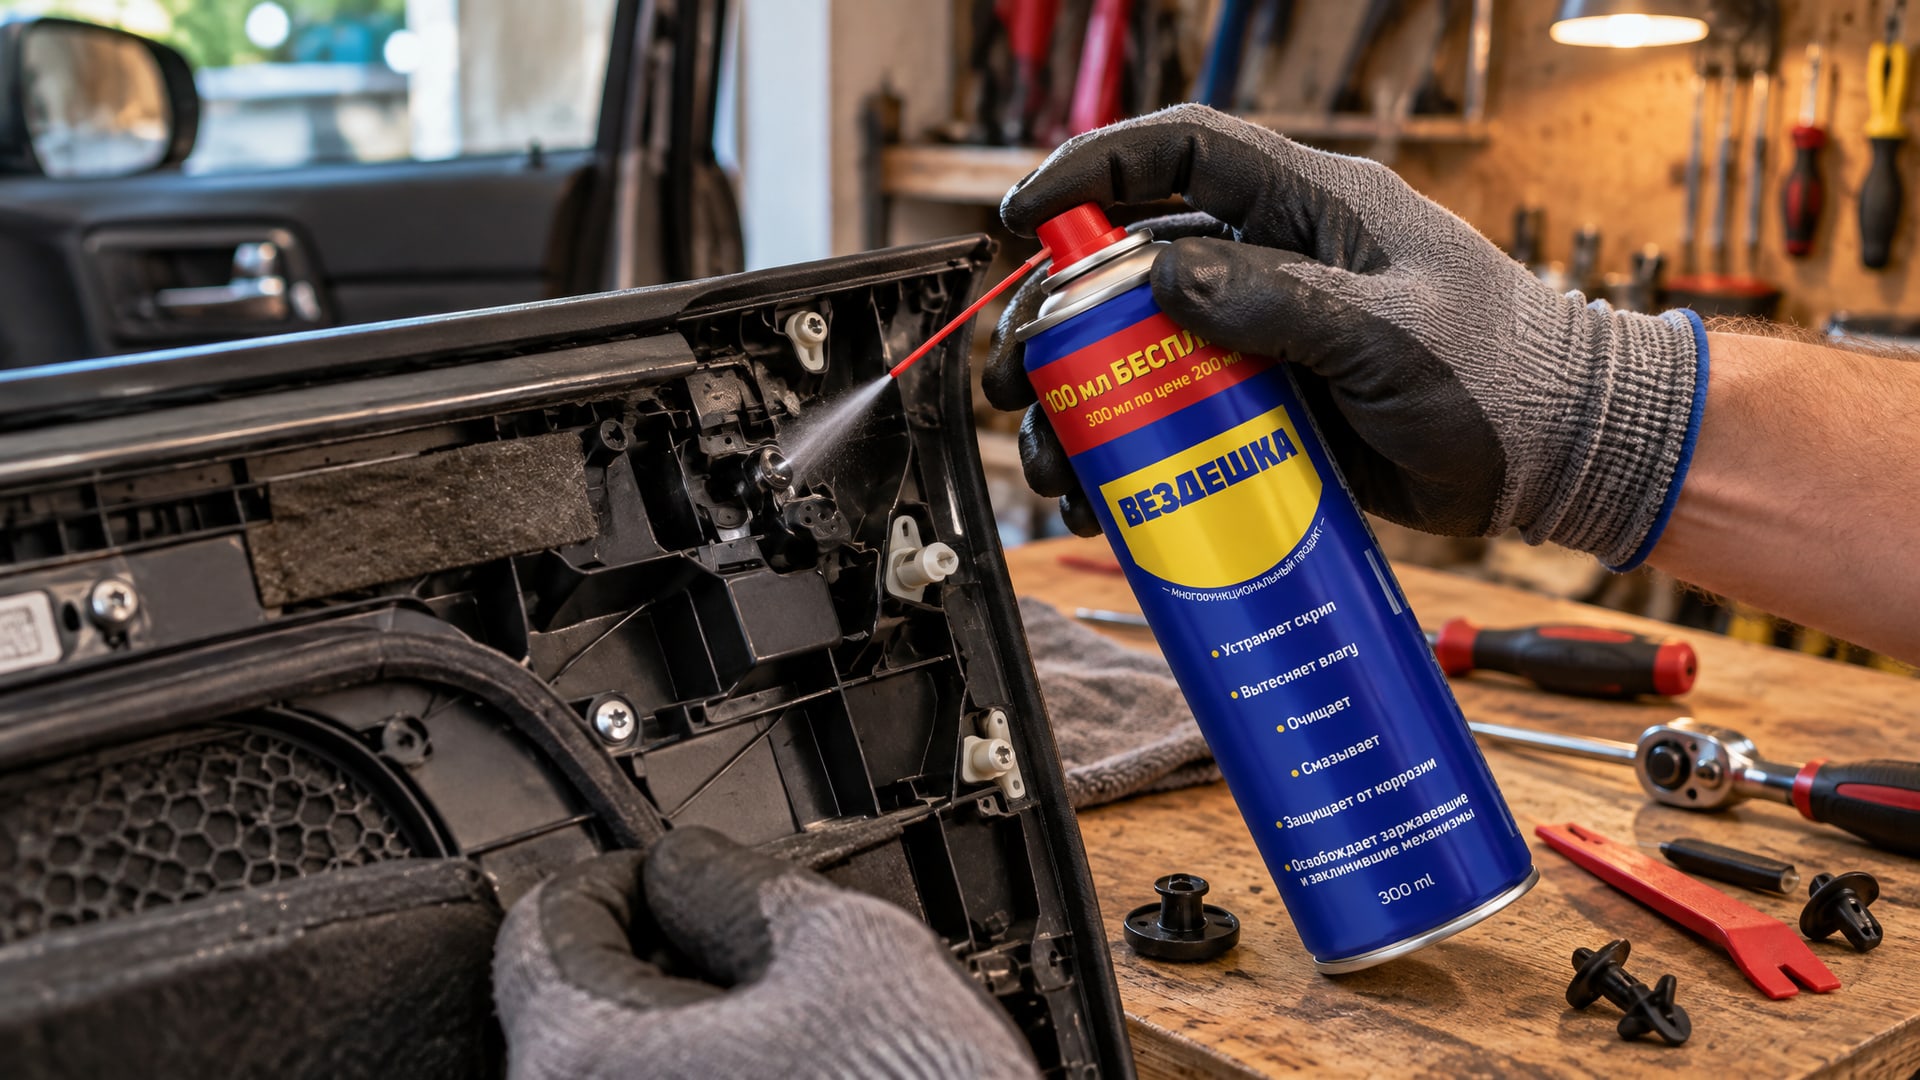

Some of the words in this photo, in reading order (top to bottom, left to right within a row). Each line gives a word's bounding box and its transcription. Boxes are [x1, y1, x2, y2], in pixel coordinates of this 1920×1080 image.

[1046, 383, 1078, 414] 100
[1078, 373, 1113, 402] мл
[1110, 329, 1210, 387] БЕСПЛ
[1085, 406, 1113, 428] 300
[1112, 399, 1135, 417] мл
[1134, 391, 1154, 408] по
[1153, 373, 1192, 400] цене
[1190, 356, 1222, 382] 200
[1222, 351, 1243, 368] мл
[1118, 427, 1299, 529] ВЕЗДЕШКА
[1220, 620, 1292, 658] Устраняет
[1294, 601, 1337, 627] скрип
[1239, 660, 1316, 700] Вытесняет
[1318, 642, 1359, 668] влагу
[1286, 696, 1351, 731] Очищает
[1300, 734, 1380, 775] Смазывает
[1283, 795, 1354, 830] Защищает
[1356, 788, 1373, 804] от
[1374, 757, 1437, 795] коррозии
[1291, 834, 1379, 872] Освобождает
[1379, 793, 1469, 842] заржавевшие
[1299, 876, 1309, 887] и
[1308, 845, 1400, 885] заклинившие
[1400, 808, 1475, 851] механизмы
[1378, 882, 1412, 906] 300
[1414, 873, 1436, 892] ml
